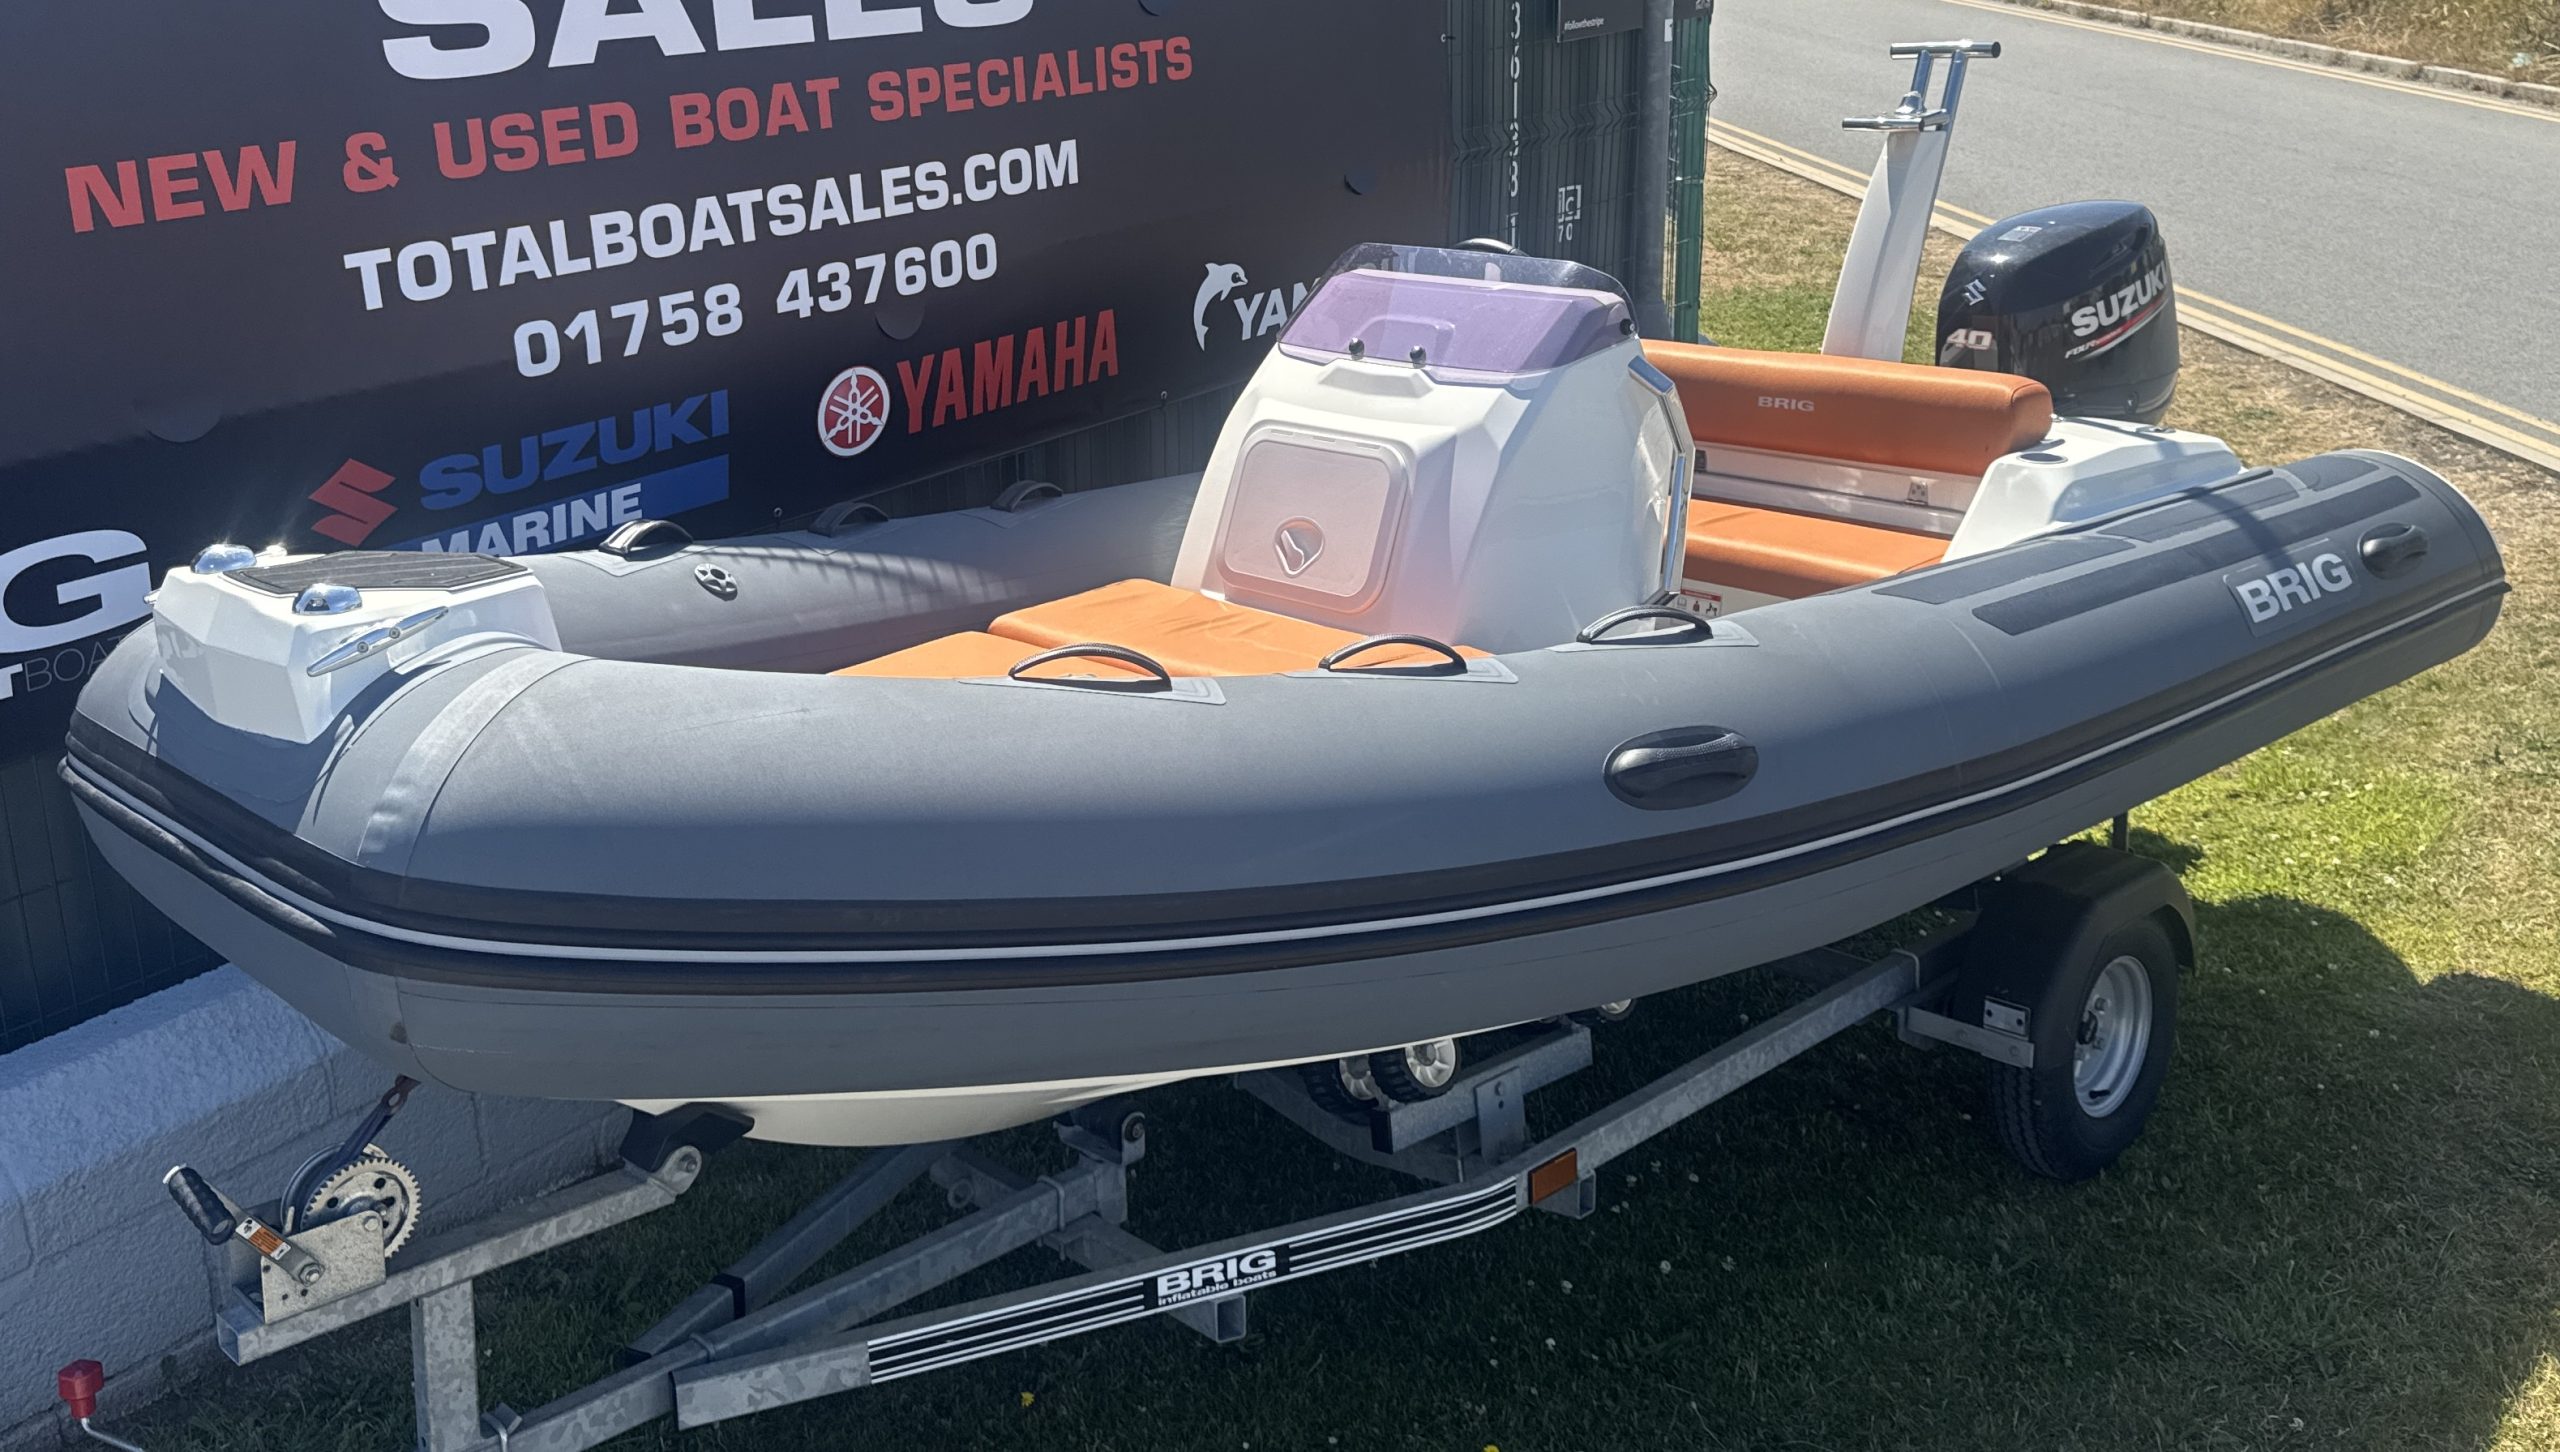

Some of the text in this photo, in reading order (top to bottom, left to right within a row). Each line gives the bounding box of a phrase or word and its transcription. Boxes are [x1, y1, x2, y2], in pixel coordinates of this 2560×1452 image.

[65, 36, 1193, 233] NEW & USED BOAT SPECIALISTS
[344, 138, 1079, 310] TOTALBOATSALES.COM
[514, 232, 998, 377] 01758 437600
[2071, 261, 2168, 337] SUZUKI
[897, 309, 1118, 433] YAMAHA
[1947, 328, 1993, 350] 40
[1757, 396, 1815, 412] BRIG
[419, 389, 730, 510] SUZUKI
[2236, 553, 2353, 624] BRIG
[1157, 1249, 1277, 1297] BRIG
[1158, 1270, 1277, 1306] inflatable boats
